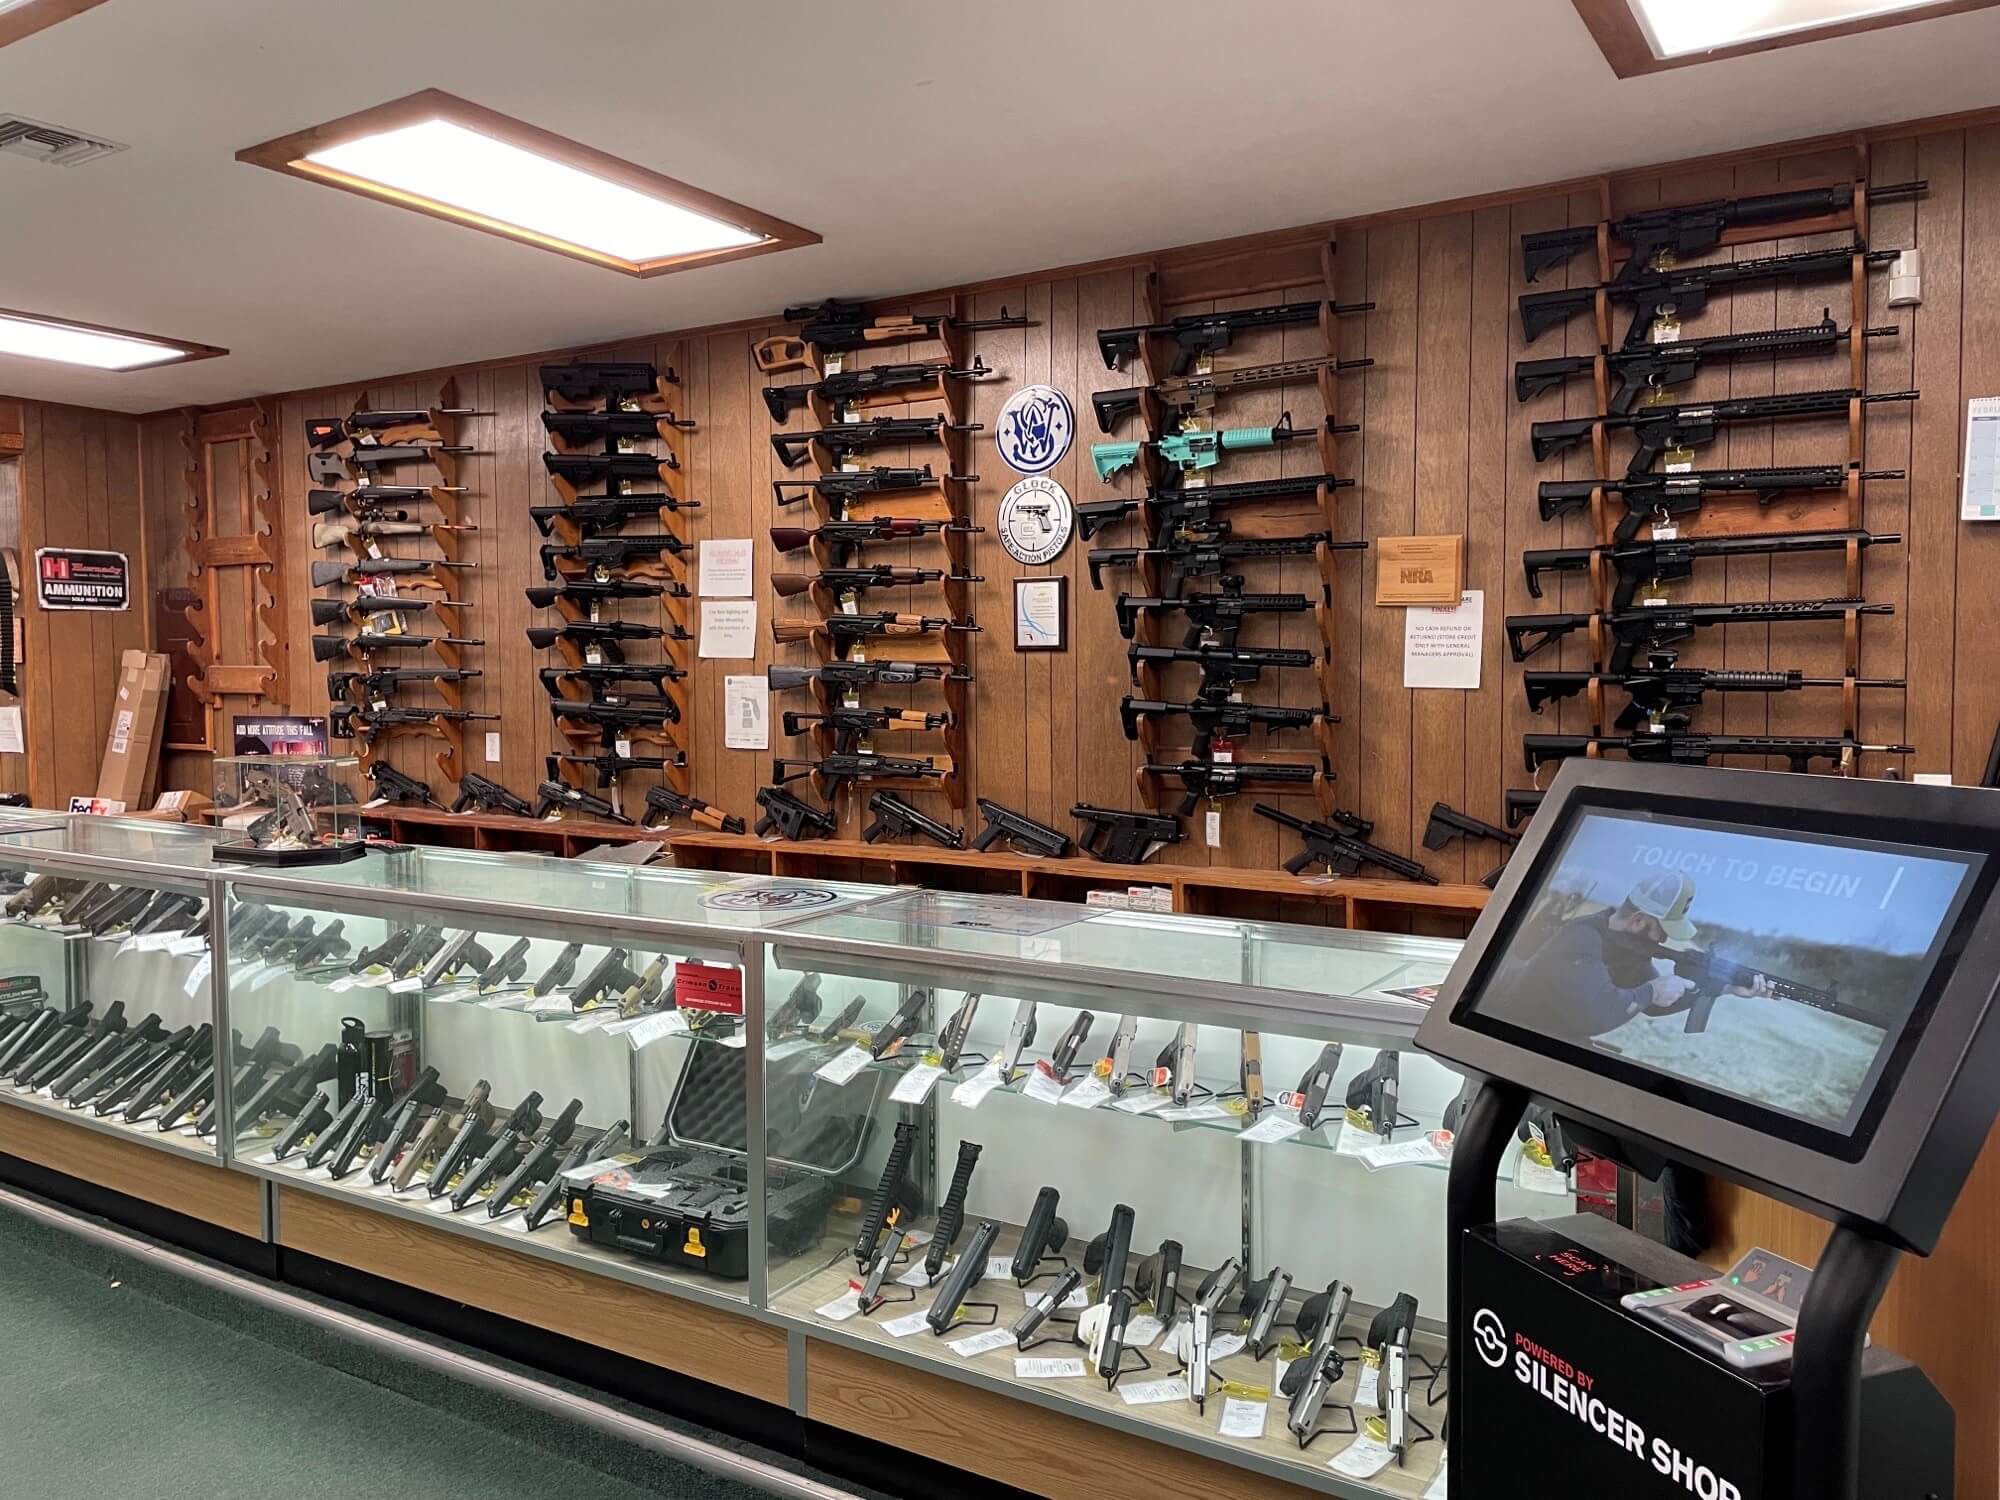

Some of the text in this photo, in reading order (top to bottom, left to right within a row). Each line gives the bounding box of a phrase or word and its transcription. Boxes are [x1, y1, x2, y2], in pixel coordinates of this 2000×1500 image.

[1013, 479, 1057, 495] GLOCK
[1043, 526, 1068, 559] PISTOLS
[1400, 568, 1434, 584] NRA
[45, 583, 123, 597] AMMUNITION
[236, 724, 247, 735] ADD
[247, 724, 261, 735] MORE
[286, 724, 299, 736] THIS
[300, 725, 314, 736] FALL
[1631, 845, 1862, 899] TOUCH TO BEGIN
[1515, 1332, 1594, 1392] POWERED BY
[1514, 1350, 1646, 1461] SILENCER
